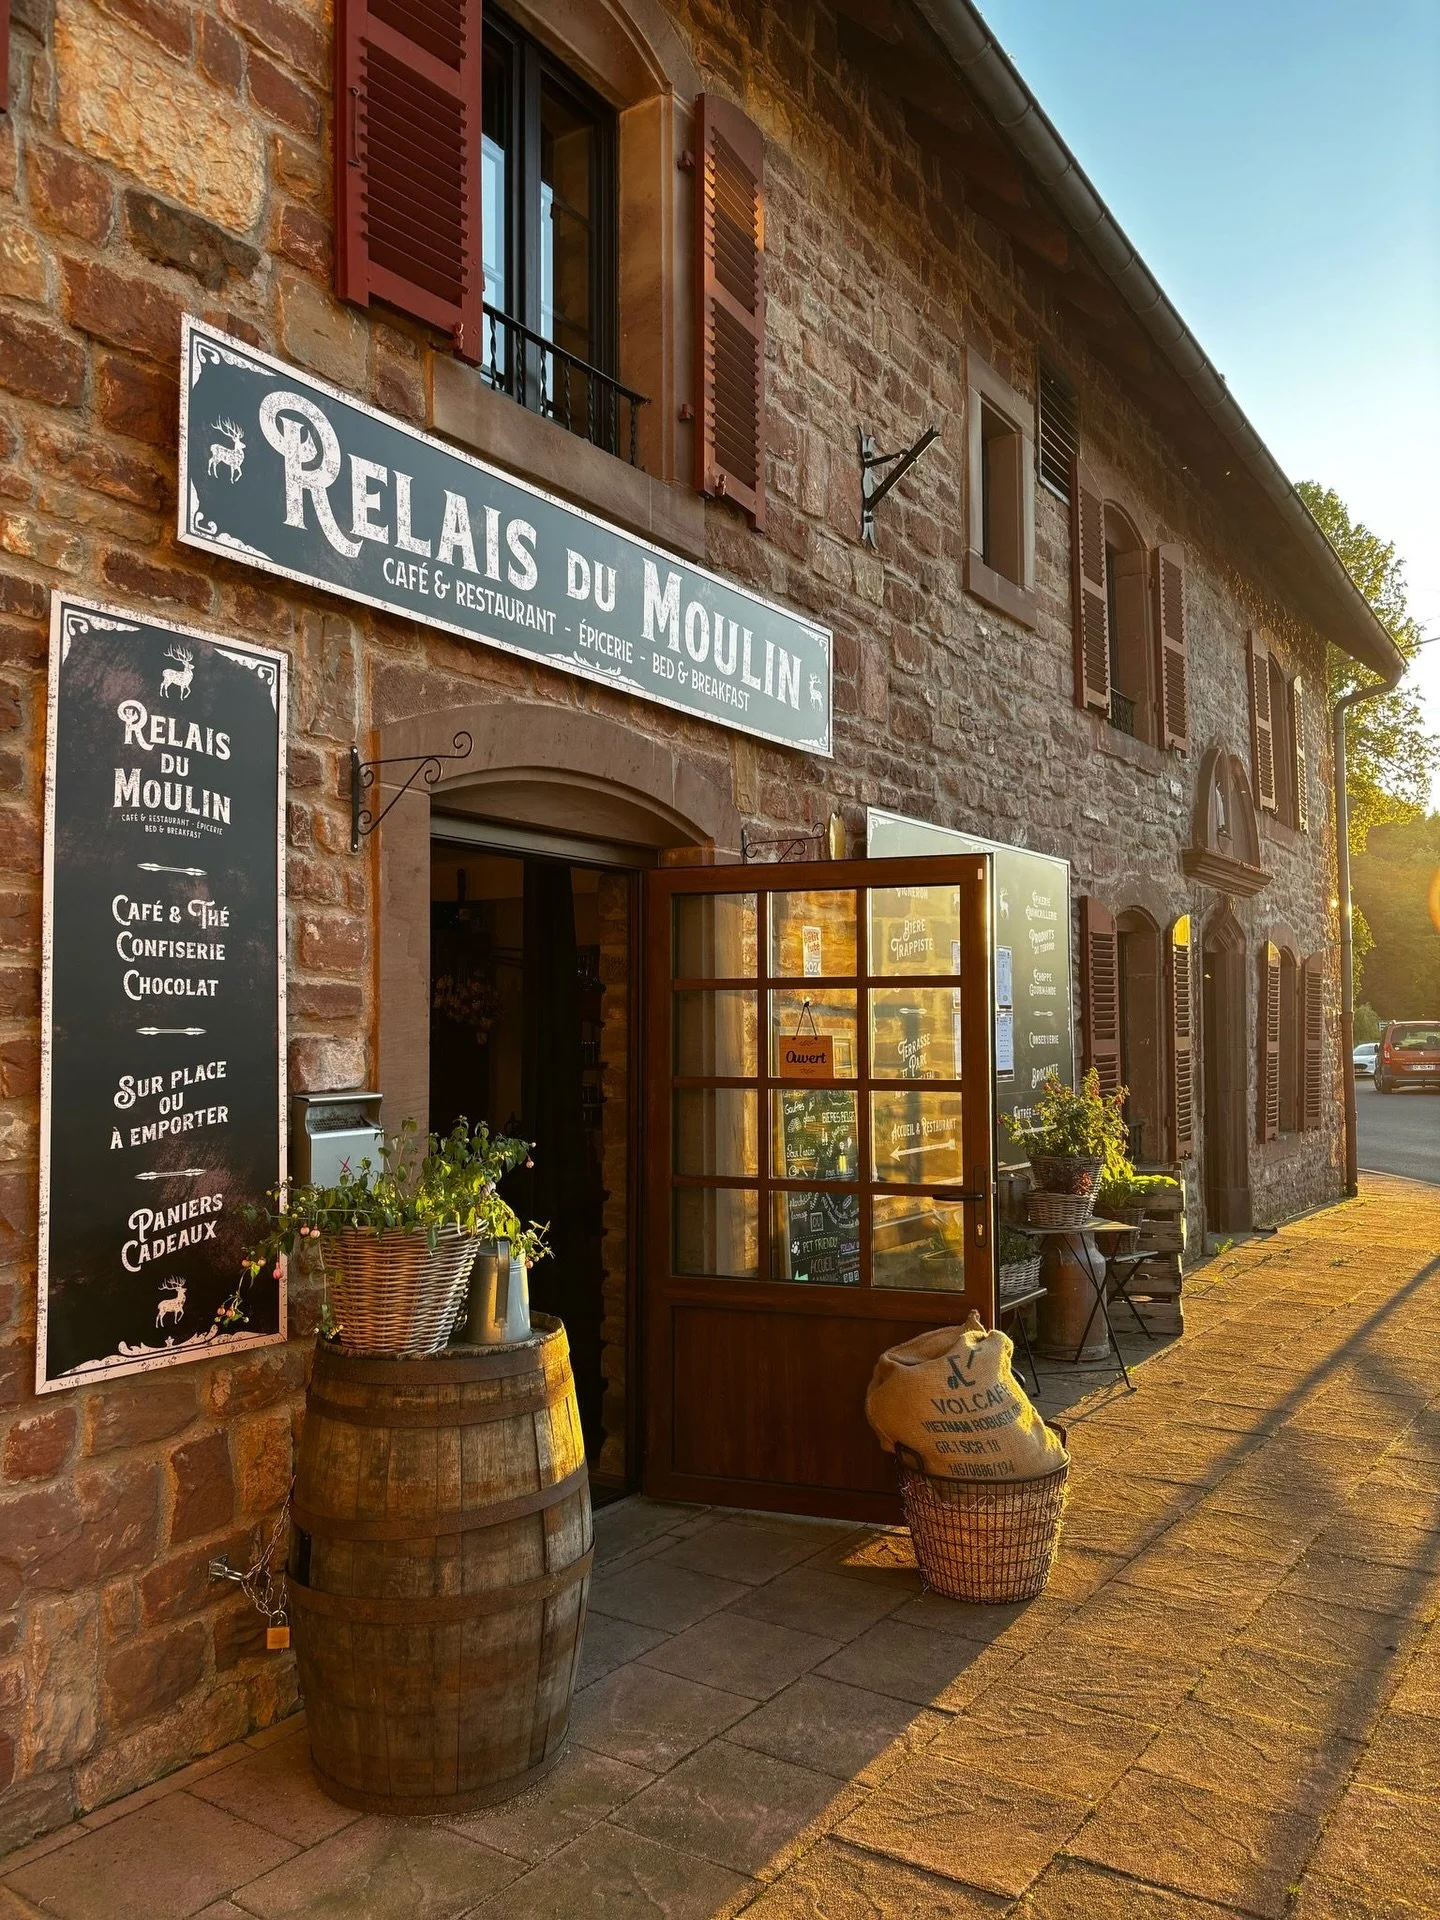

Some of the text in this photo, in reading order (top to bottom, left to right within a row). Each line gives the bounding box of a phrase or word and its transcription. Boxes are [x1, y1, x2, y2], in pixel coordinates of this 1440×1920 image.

[259, 390, 802, 711] RELAIS DU MOULIN
[383, 556, 429, 595] CAFÉ
[434, 569, 450, 599] &
[456, 580, 557, 635] RESTAURANT
[579, 619, 633, 665] ÉPICERIE
[652, 652, 675, 679] BED
[677, 661, 688, 685] &
[691, 667, 750, 712] BREAKFAST
[117, 700, 231, 762] RELAIS
[160, 753, 190, 777] DU
[112, 767, 231, 826] MOULIN
[121, 813, 138, 822] CAFÉ
[140, 813, 147, 822] &
[149, 814, 190, 827] RESTAURANT
[196, 821, 224, 836] ÉPICERIE
[144, 825, 202, 840] BED & BREAKFAST
[111, 894, 230, 929] CAFÉ & THÉ
[116, 930, 226, 962] CONFISERIE
[890, 937, 934, 961] TRAPPISTE
[122, 969, 219, 1001] CHOCOLAT
[897, 1033, 931, 1062] TERRASSE
[1028, 1031, 1060, 1048] CONSERVERIE
[786, 1050, 827, 1064] Ouvert
[113, 1060, 227, 1110] SUR PLACE
[159, 1092, 184, 1116] OU
[110, 1105, 230, 1151] À EMPORTER
[891, 1123, 915, 1144] ACCUEIL
[921, 1116, 957, 1137] RESTAURANT
[127, 1193, 223, 1244] PANIERS
[120, 1219, 217, 1273] CADEAUX
